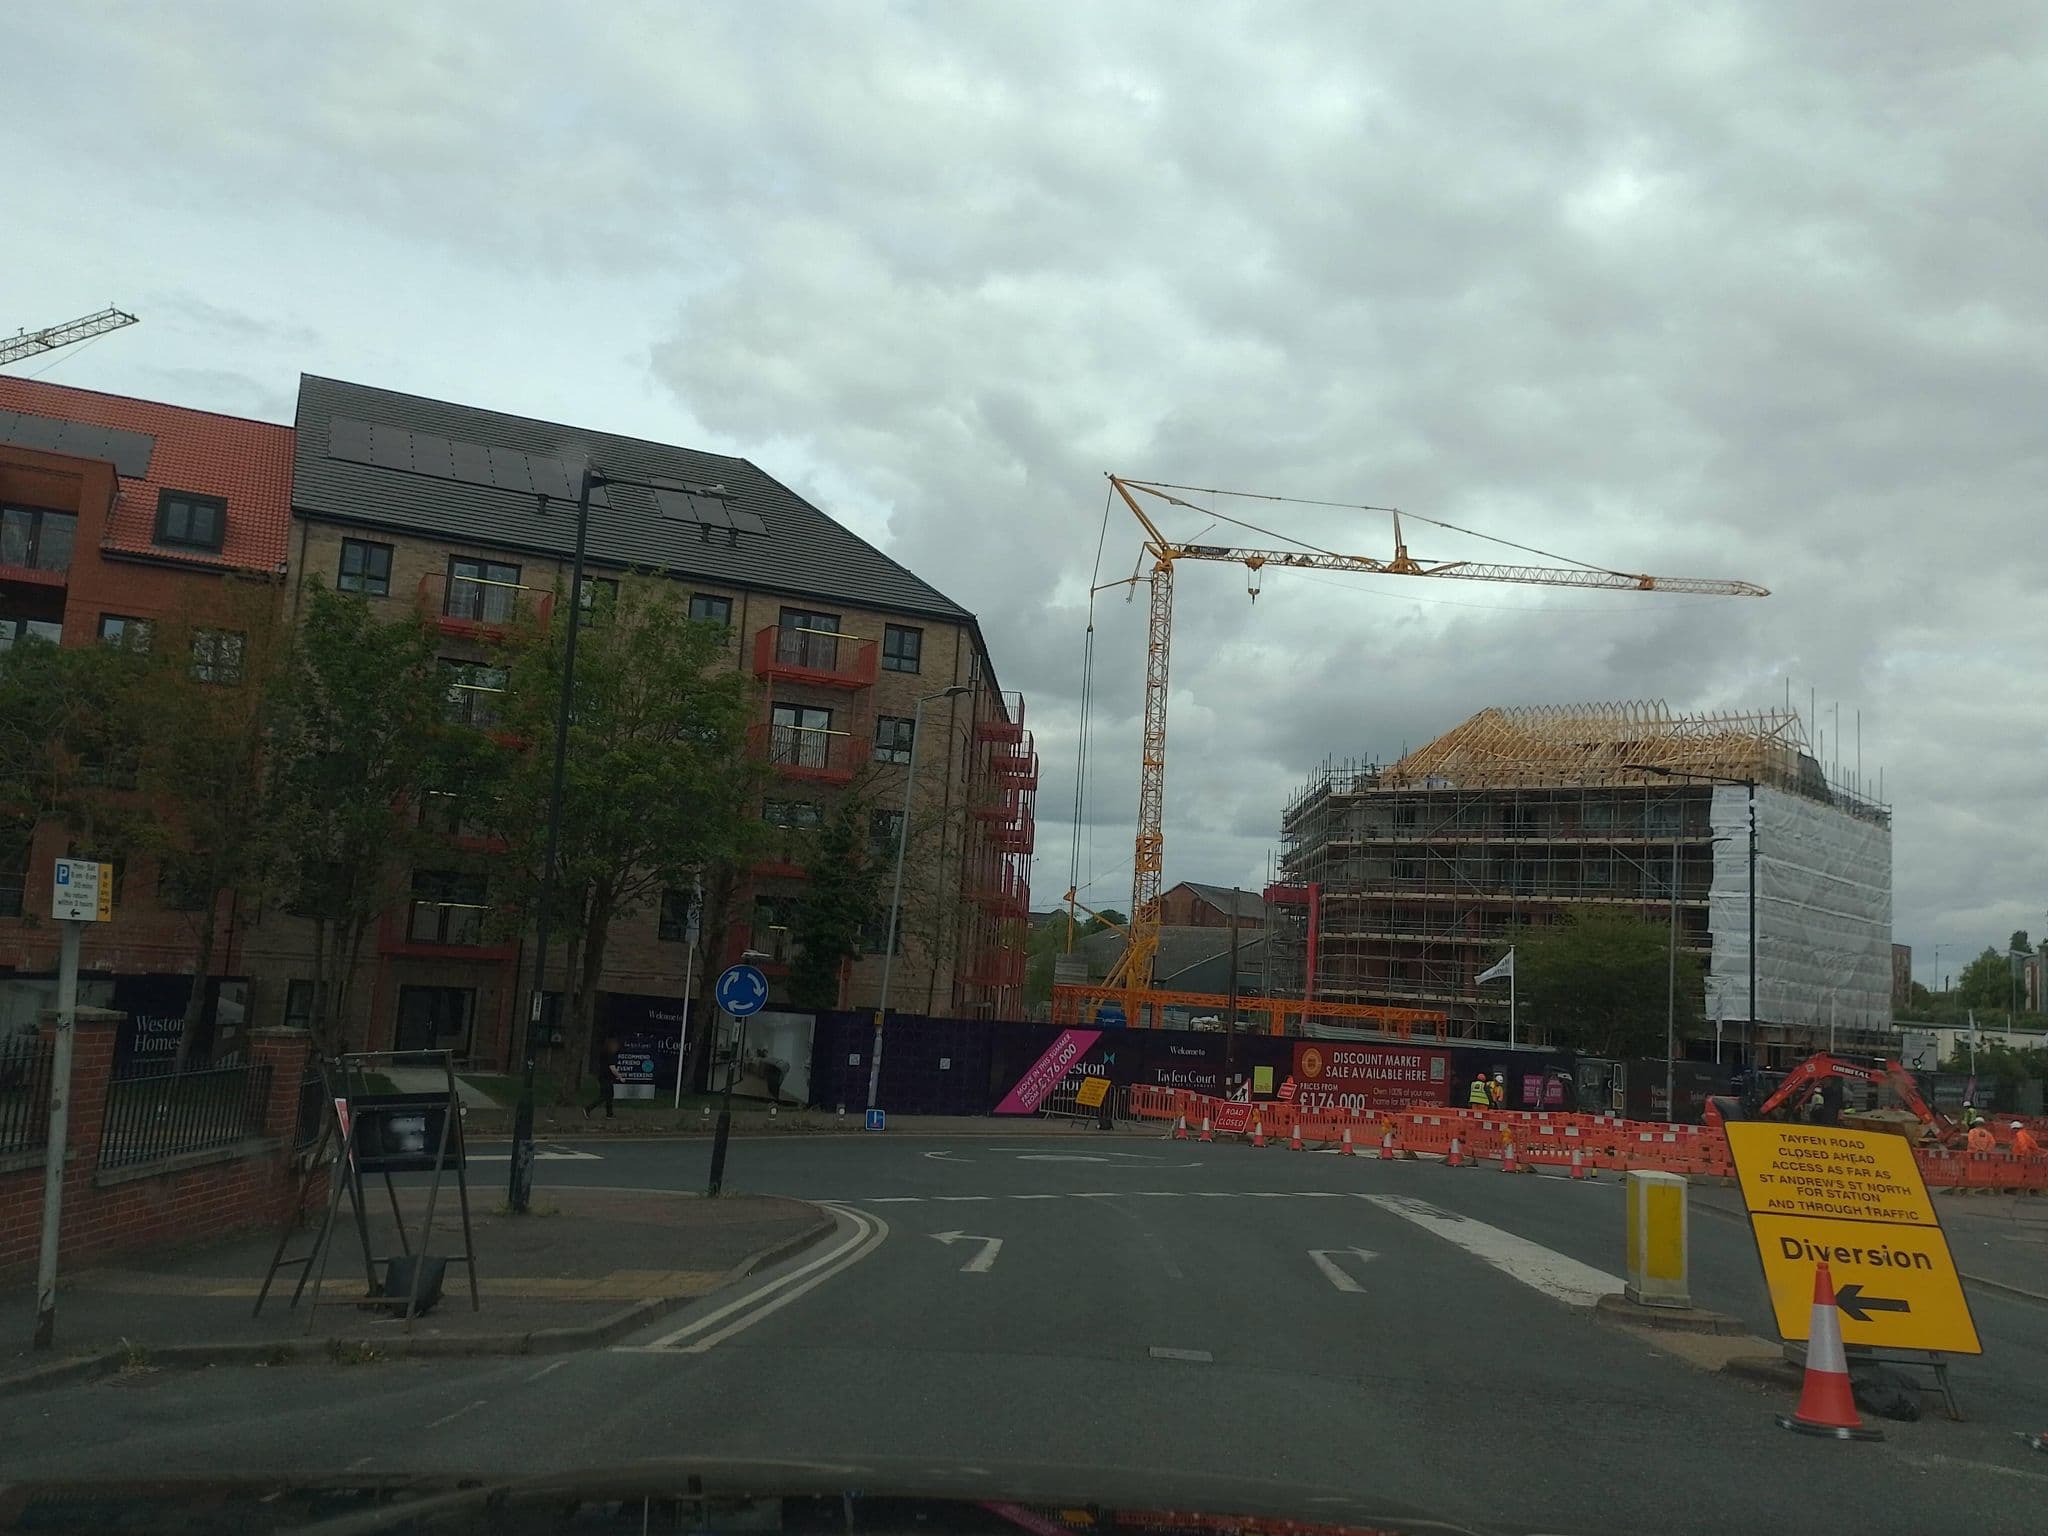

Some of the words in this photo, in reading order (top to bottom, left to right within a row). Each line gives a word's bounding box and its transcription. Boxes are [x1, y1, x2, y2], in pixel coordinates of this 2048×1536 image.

[135, 1015, 185, 1032] Weston
[134, 1034, 181, 1052] Homes
[1038, 1056, 1051, 1070] THIS
[1068, 1061, 1105, 1075] eston
[1333, 1051, 1382, 1066] DISCOUNT
[1384, 1054, 1422, 1068] MARKET
[1188, 1070, 1216, 1084] Court
[1325, 1065, 1349, 1078] SALE
[1351, 1067, 1403, 1081] AVAILABLE
[1404, 1069, 1428, 1082] HERE
[1300, 1082, 1321, 1091] PRICES
[1321, 1083, 1339, 1091] FROM
[1226, 1108, 1244, 1116] ROAD
[1218, 1118, 1244, 1127] CLOSED
[1780, 1134, 1826, 1146] TAYFEN
[1830, 1138, 1865, 1149] ROAD
[1778, 1147, 1829, 1160] CLOSED
[1833, 1152, 1875, 1164] AHEAD
[1772, 1161, 1824, 1173] ACCESS
[1827, 1166, 1843, 1175] AS
[1847, 1167, 1871, 1177] FAR
[1875, 1170, 1891, 1180] AS
[1759, 1173, 1775, 1183] ST
[1847, 1180, 1864, 1190] ST
[1867, 1183, 1912, 1195] NORTH
[1797, 1187, 1824, 1197] FOR
[1827, 1190, 1881, 1203] STATION
[1768, 1199, 1795, 1209] AND
[1798, 1200, 1863, 1216] THROUGH
[1864, 1206, 1919, 1220] TRAFFIC
[1780, 1236, 1933, 1270] Diversion
